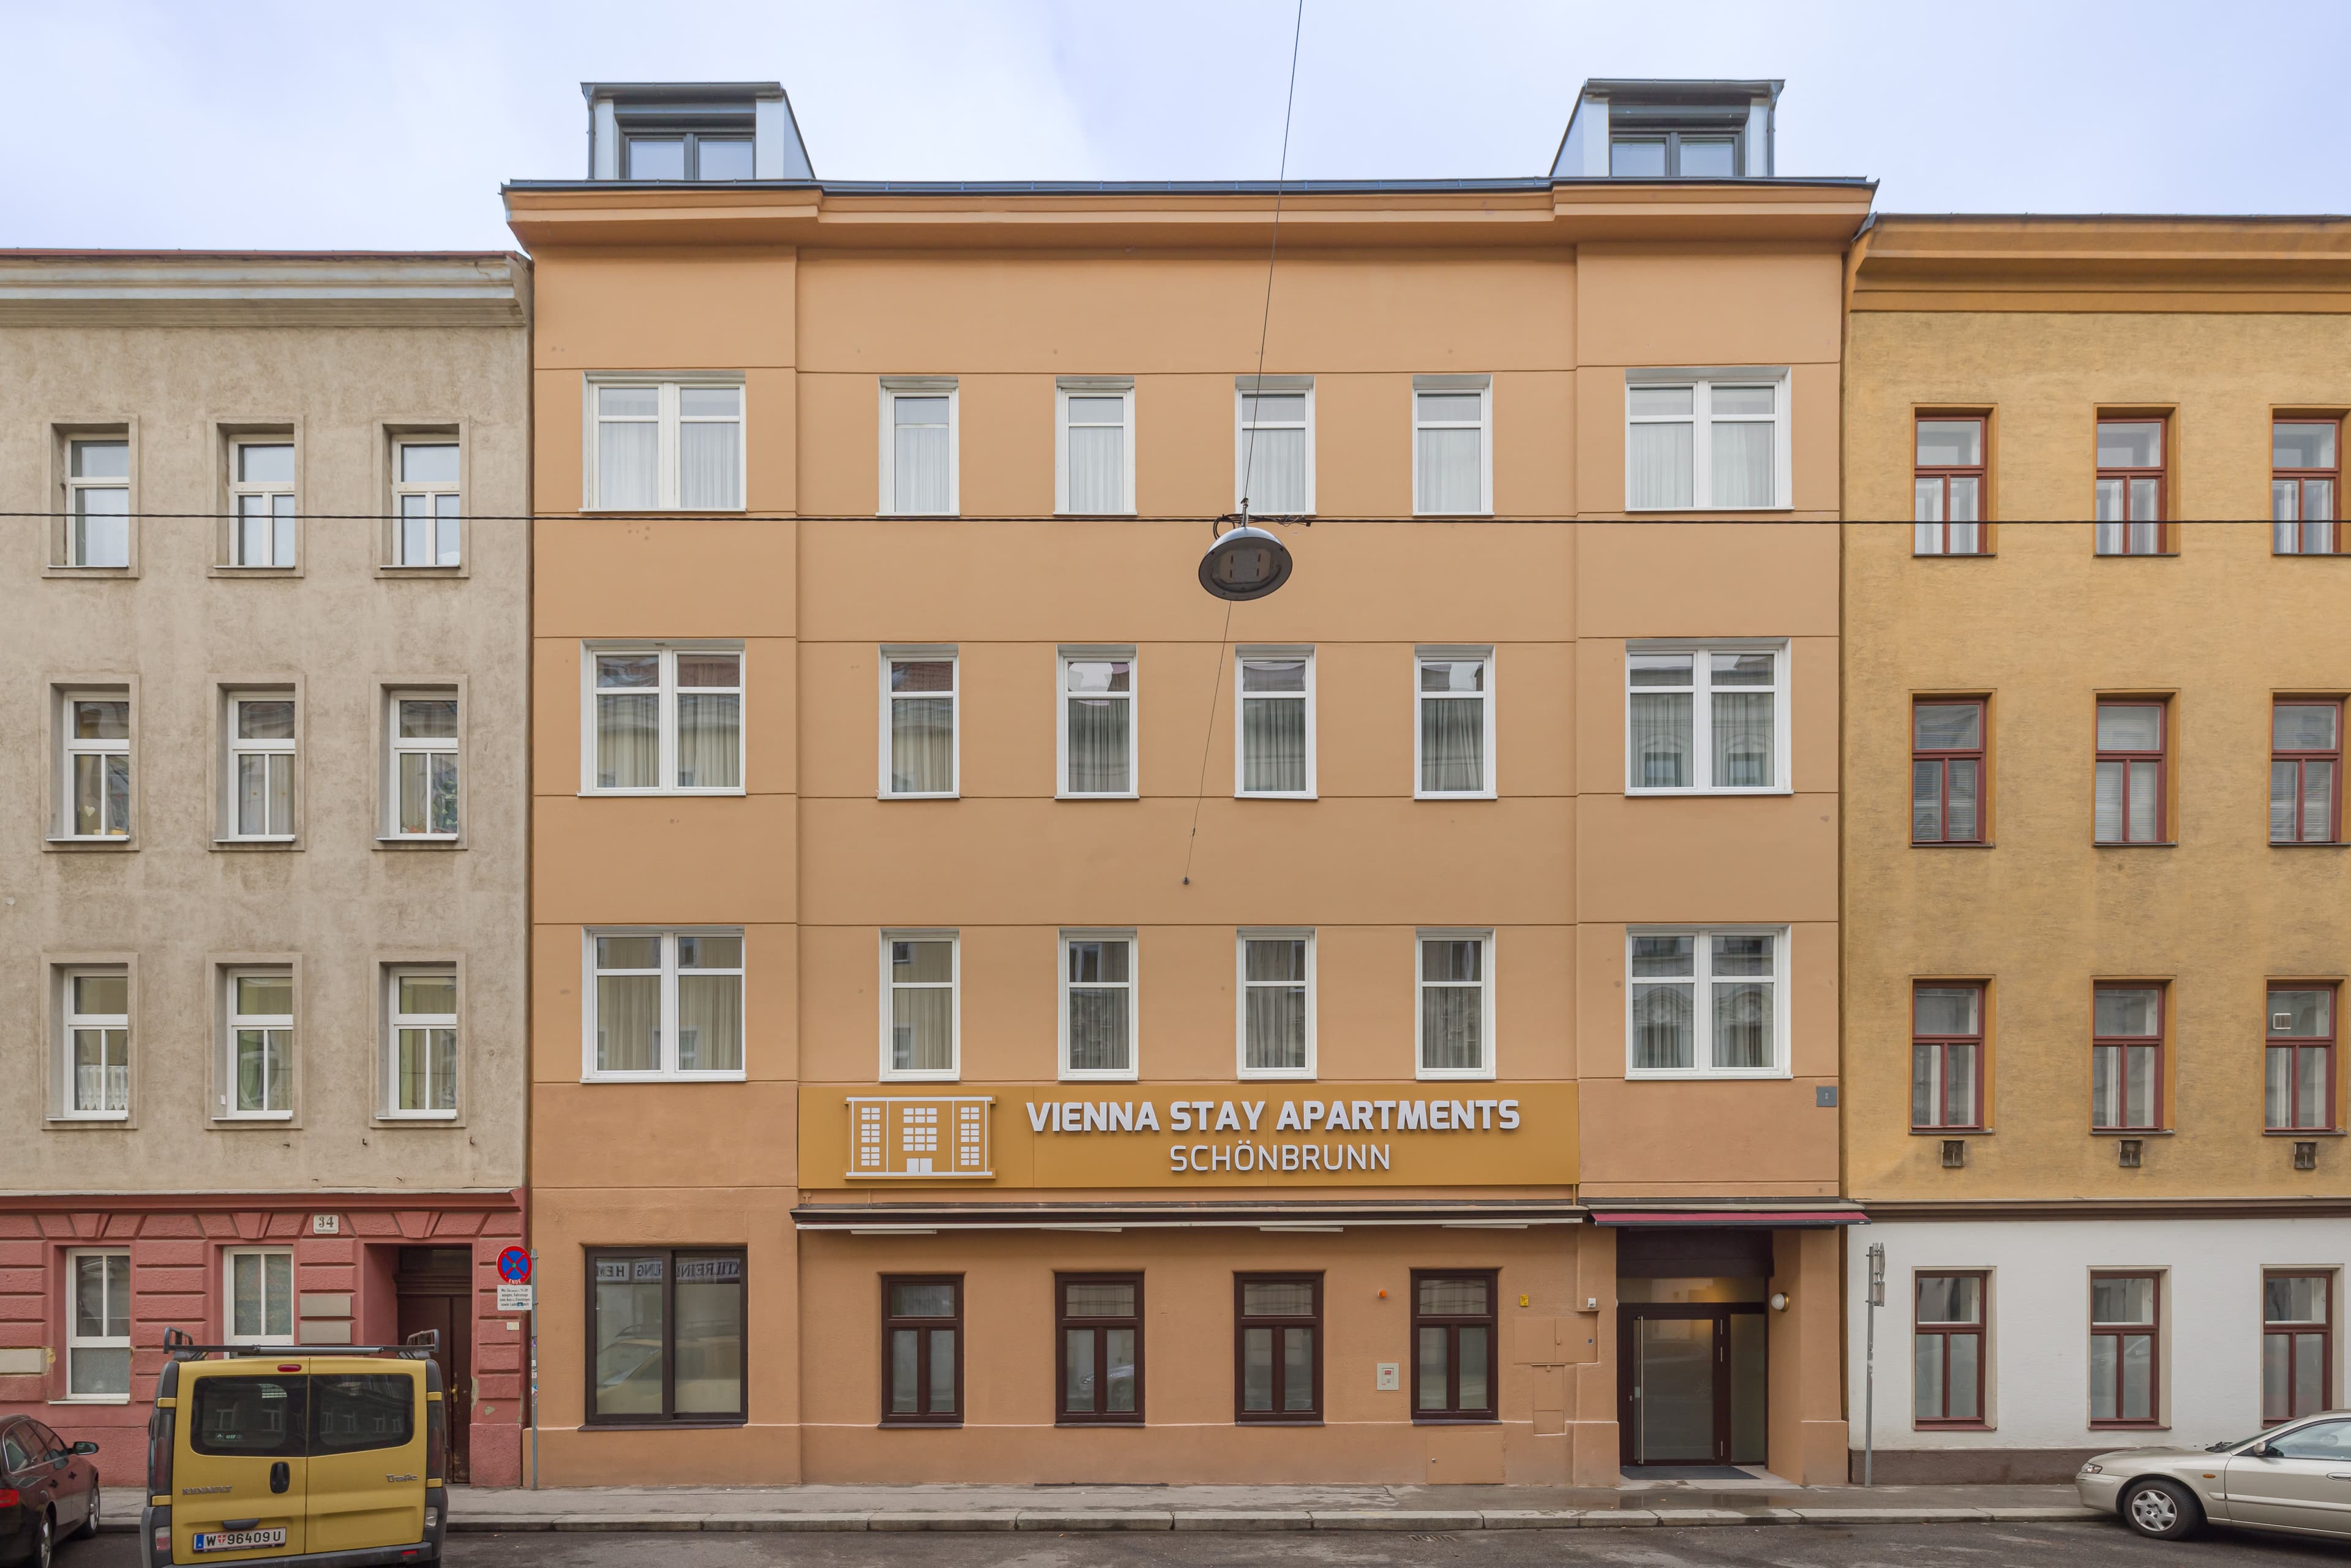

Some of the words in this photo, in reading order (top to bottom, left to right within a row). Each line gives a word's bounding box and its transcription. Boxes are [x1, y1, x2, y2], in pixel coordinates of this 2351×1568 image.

[1026, 1101, 1160, 1131] VIENNA
[1170, 1101, 1265, 1131] STAY
[1275, 1100, 1520, 1130] APARTMENTS
[1170, 1139, 1390, 1171] SCHÖNBRUNN
[318, 1216, 334, 1228] 34
[386, 1473, 418, 1482] Trafic
[182, 1485, 232, 1495] RENAULT
[206, 1536, 216, 1547] W
[228, 1532, 269, 1545] 96409
[273, 1531, 280, 1541] U
